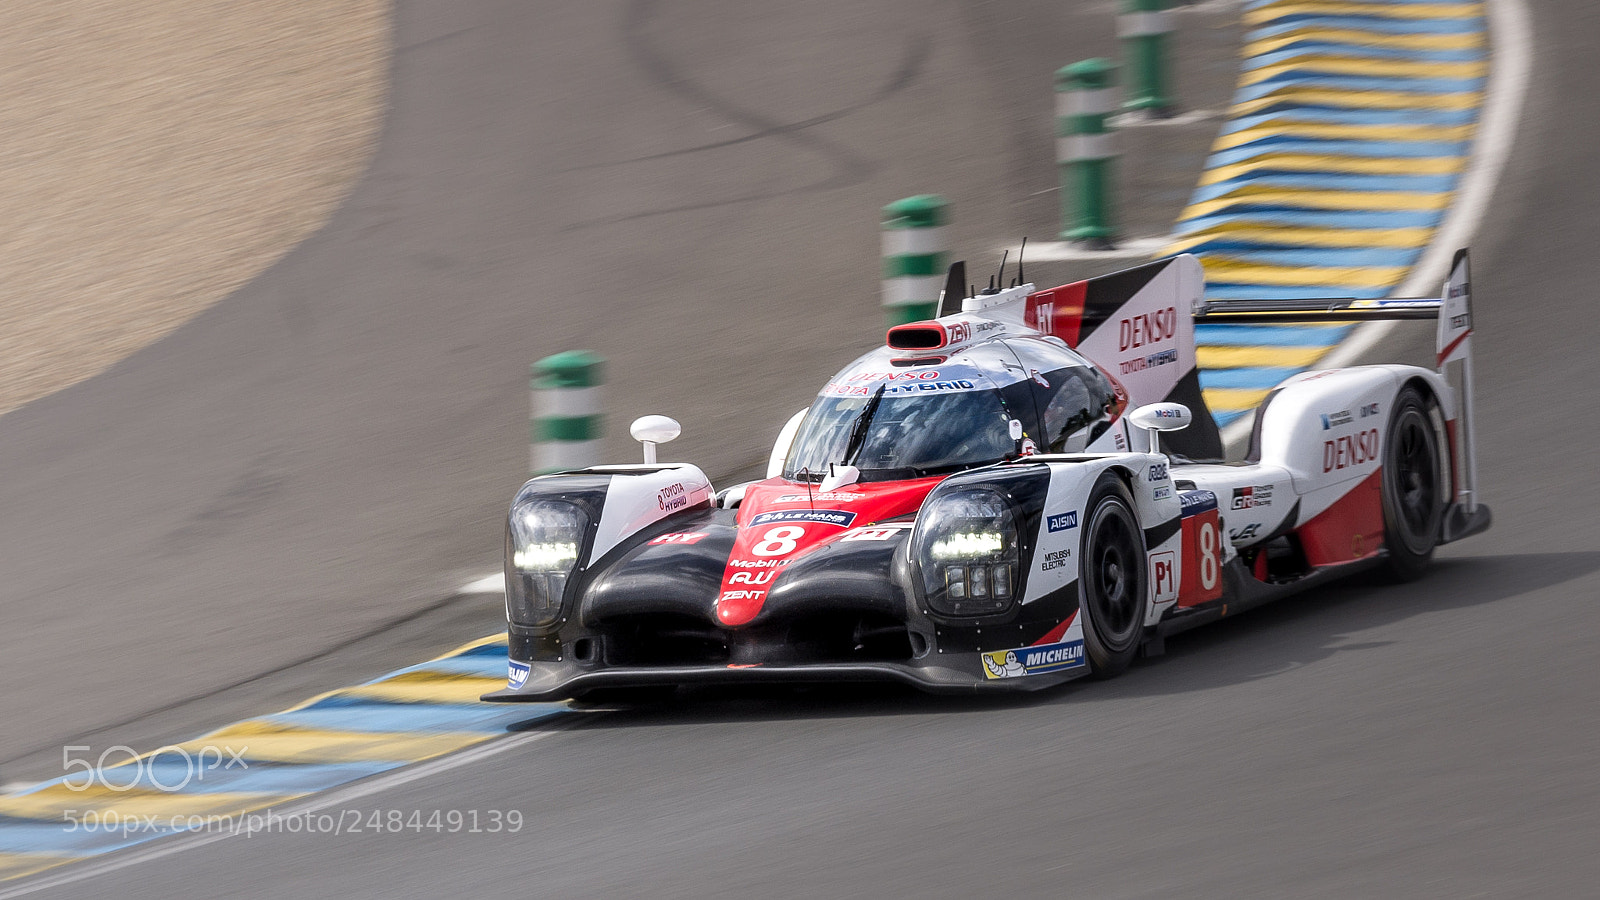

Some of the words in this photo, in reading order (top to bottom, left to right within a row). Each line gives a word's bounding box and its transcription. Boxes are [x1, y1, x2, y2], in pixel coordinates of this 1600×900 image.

[1119, 307, 1176, 352] DENSO
[848, 371, 939, 382] DENSO
[883, 380, 974, 394] HYBRID
[1155, 410, 1174, 418] Mobil
[1323, 428, 1379, 473] DENSO
[660, 483, 684, 498] TOYOTA
[658, 495, 664, 510] 8
[1051, 514, 1076, 529] AISIN
[653, 533, 705, 543] HY
[752, 526, 806, 556] 8
[730, 559, 777, 567] Mobil
[1201, 522, 1217, 590] 8
[1042, 559, 1066, 571] ELECTRIC
[1155, 559, 1173, 594] P1
[721, 590, 765, 601] ZENT
[1026, 645, 1083, 666] MICHELIN
